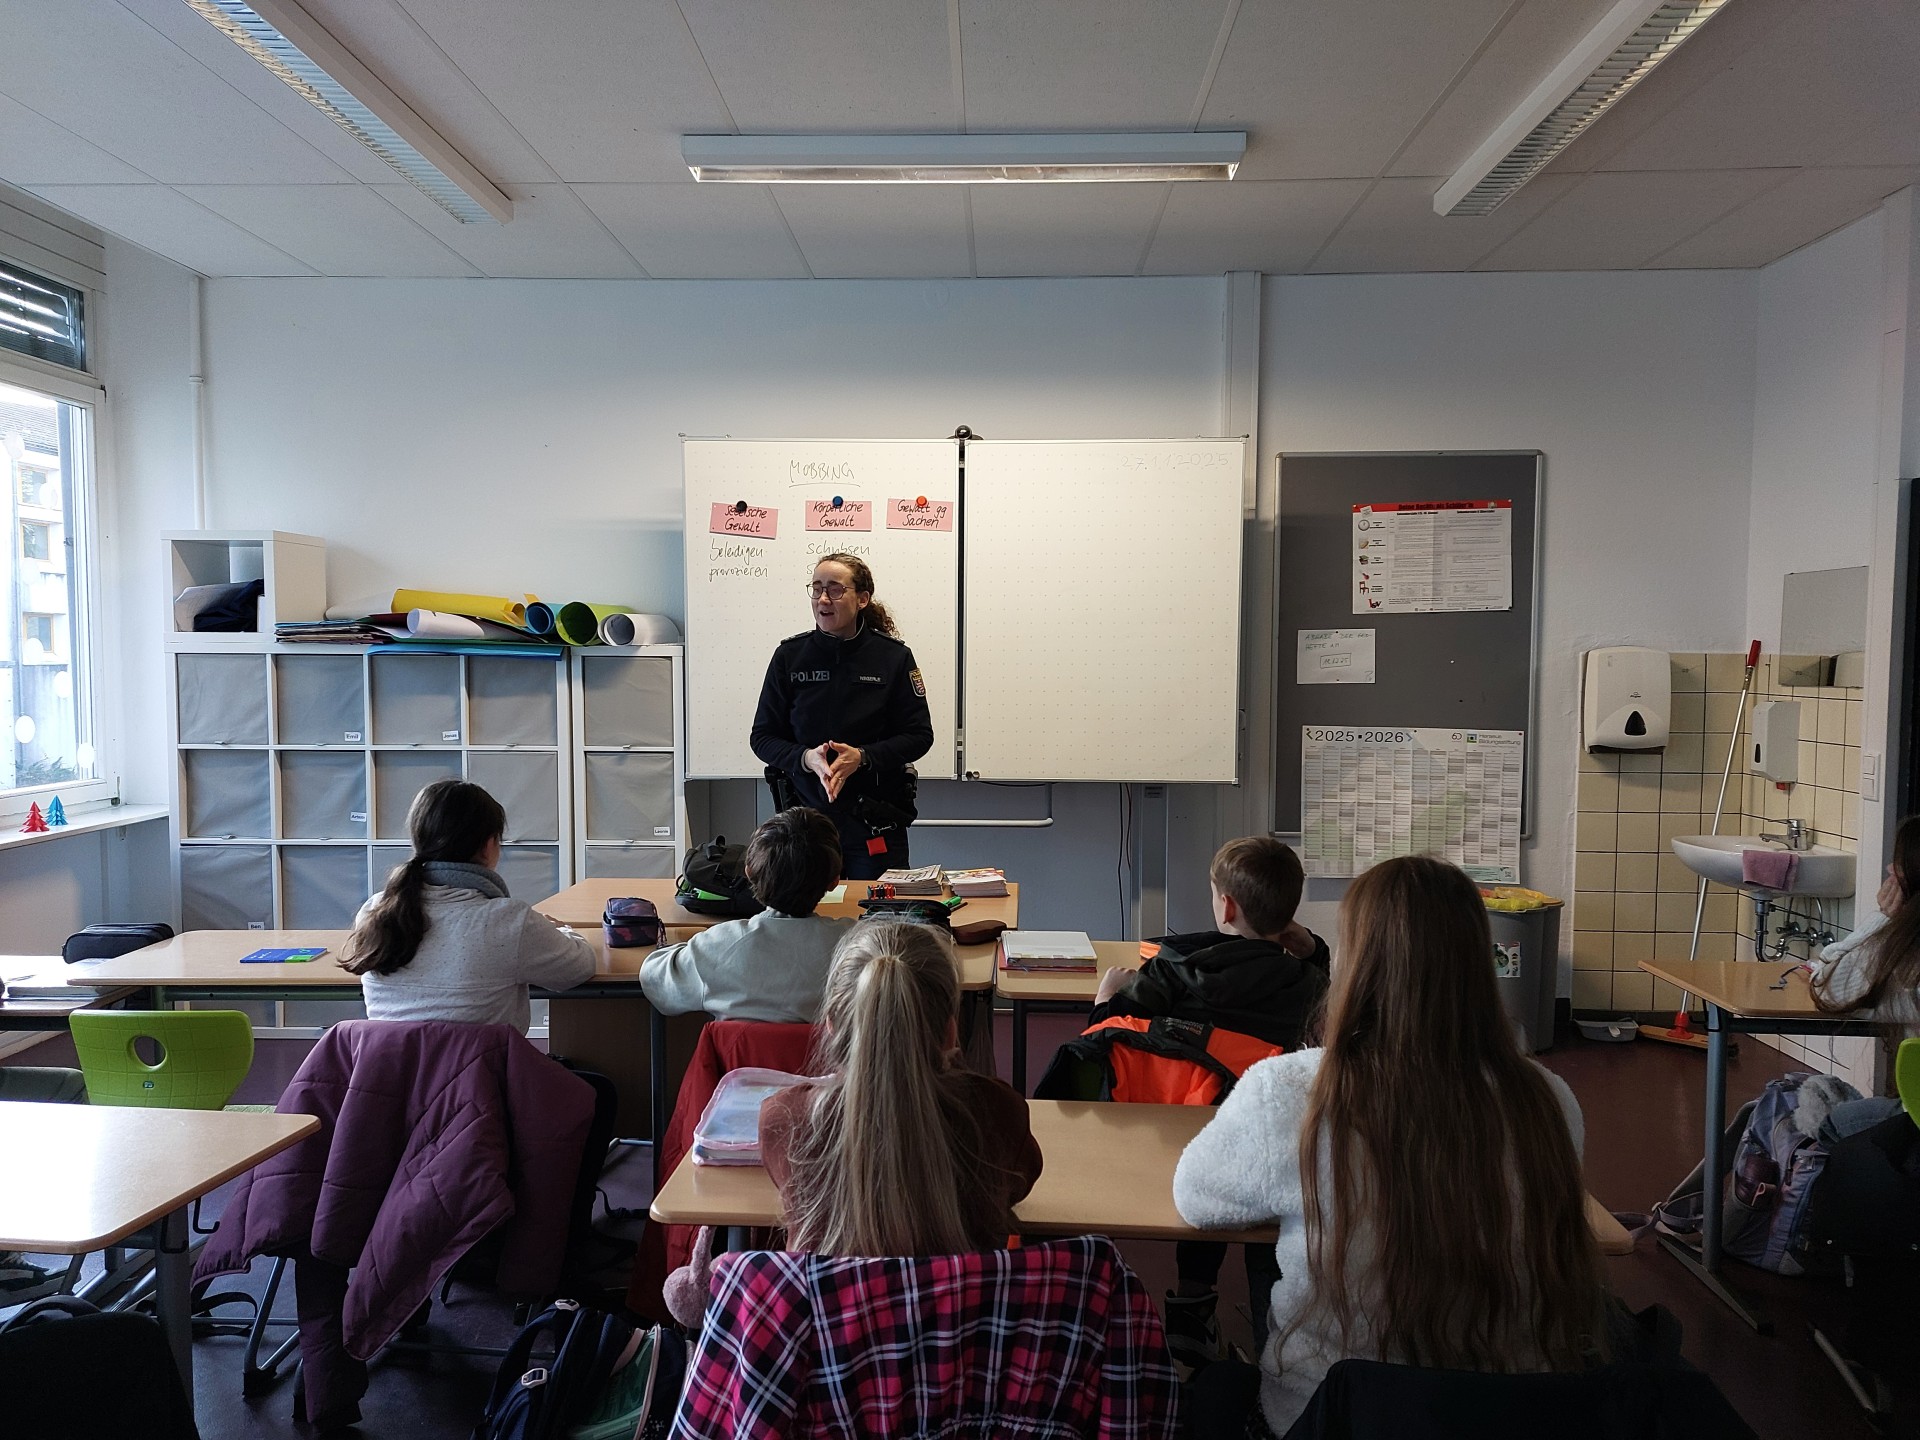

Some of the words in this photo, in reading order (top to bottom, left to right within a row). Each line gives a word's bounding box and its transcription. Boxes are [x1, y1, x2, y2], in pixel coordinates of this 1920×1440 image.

[789, 459, 855, 484] MOBBING
[724, 517, 761, 533] Gewalt
[819, 514, 856, 528] Gewalt
[902, 513, 940, 529] Sachen
[709, 538, 764, 566] beleidigen
[708, 566, 768, 583] provozieren
[790, 670, 830, 683] POLIZEI
[1314, 730, 1355, 742] 2025
[1364, 731, 1404, 743] 2026
